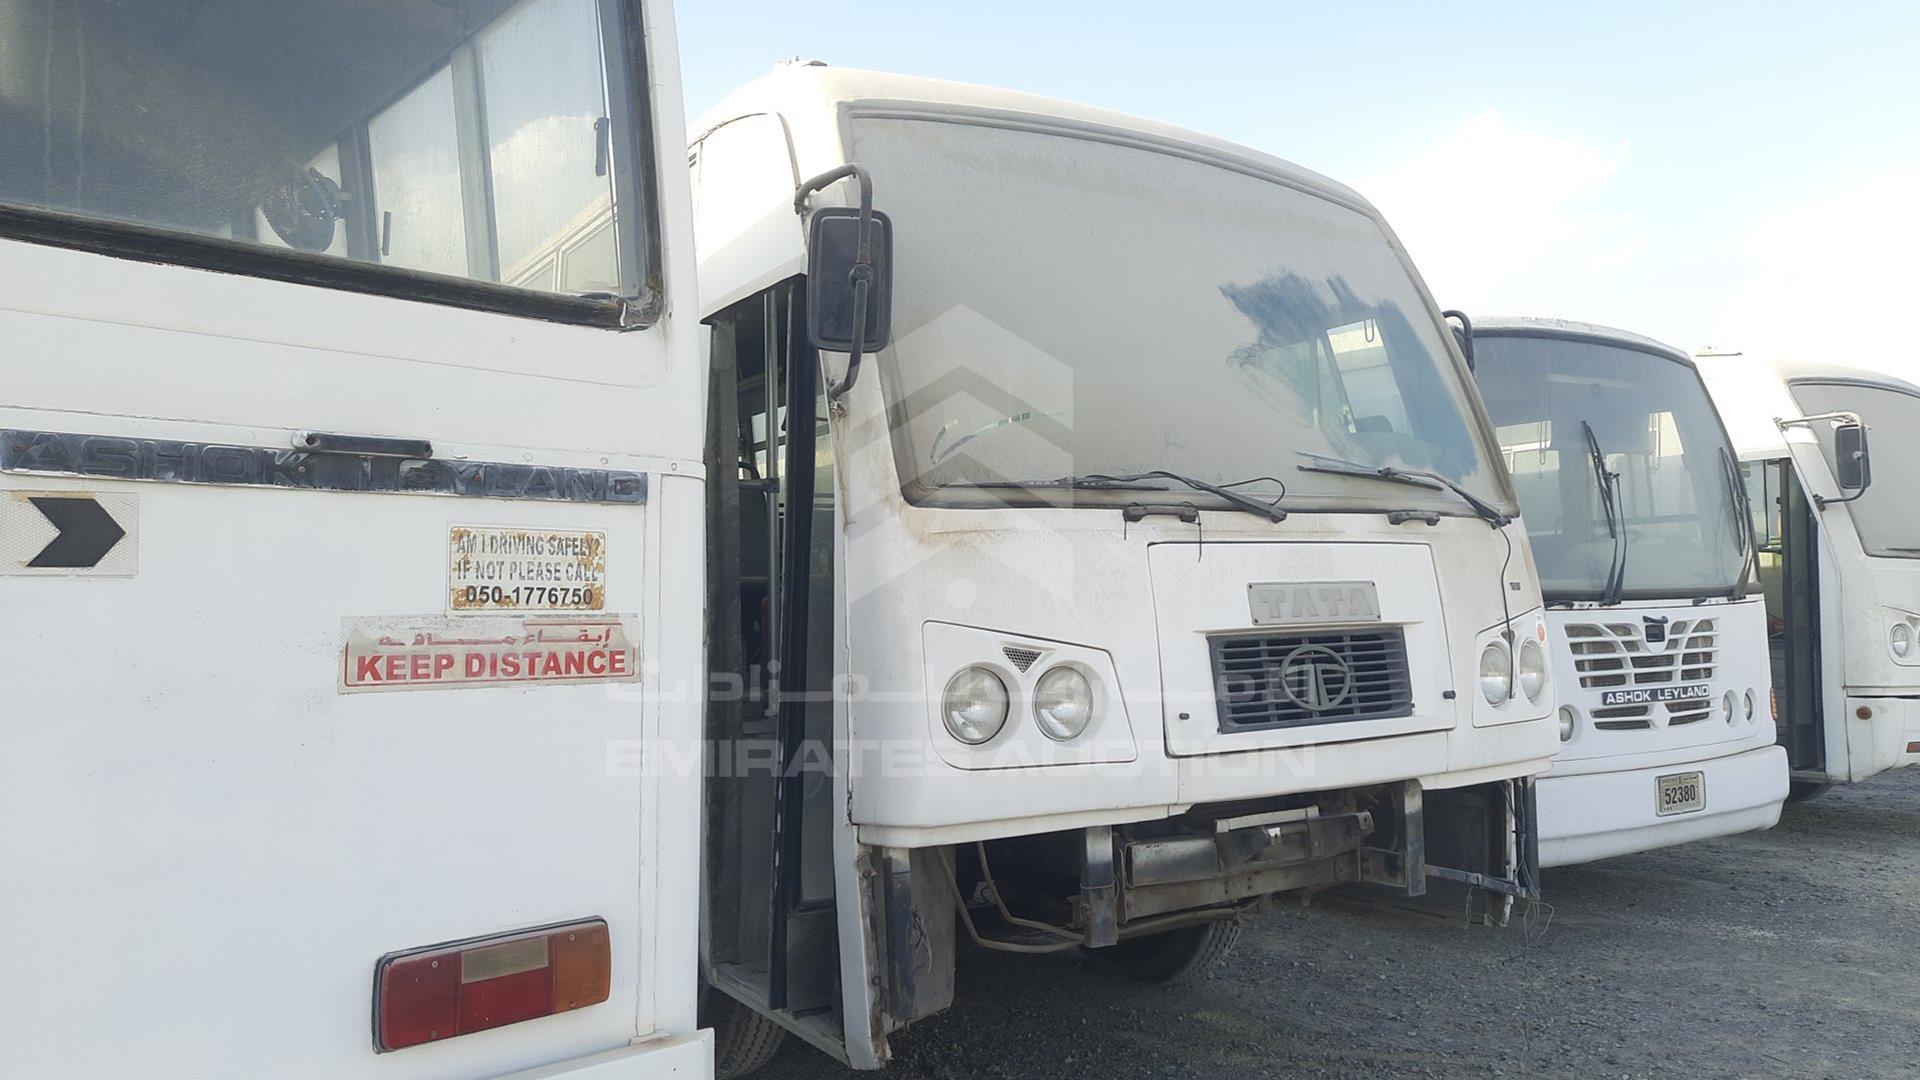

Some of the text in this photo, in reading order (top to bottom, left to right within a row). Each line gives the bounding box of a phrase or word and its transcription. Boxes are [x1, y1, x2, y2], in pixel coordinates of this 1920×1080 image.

[12, 432, 310, 490] ASHOK
[457, 533, 600, 558] AM I DRIVING SAFELY?
[457, 559, 598, 582] IF NOT PLEASE CALL
[466, 584, 593, 606] 050-1776750
[1258, 588, 1374, 618] TATA
[356, 650, 626, 682] KEEP DISTANCE
[1605, 685, 1709, 705] ASHOK LEYLAND
[1664, 784, 1696, 805] 52380
